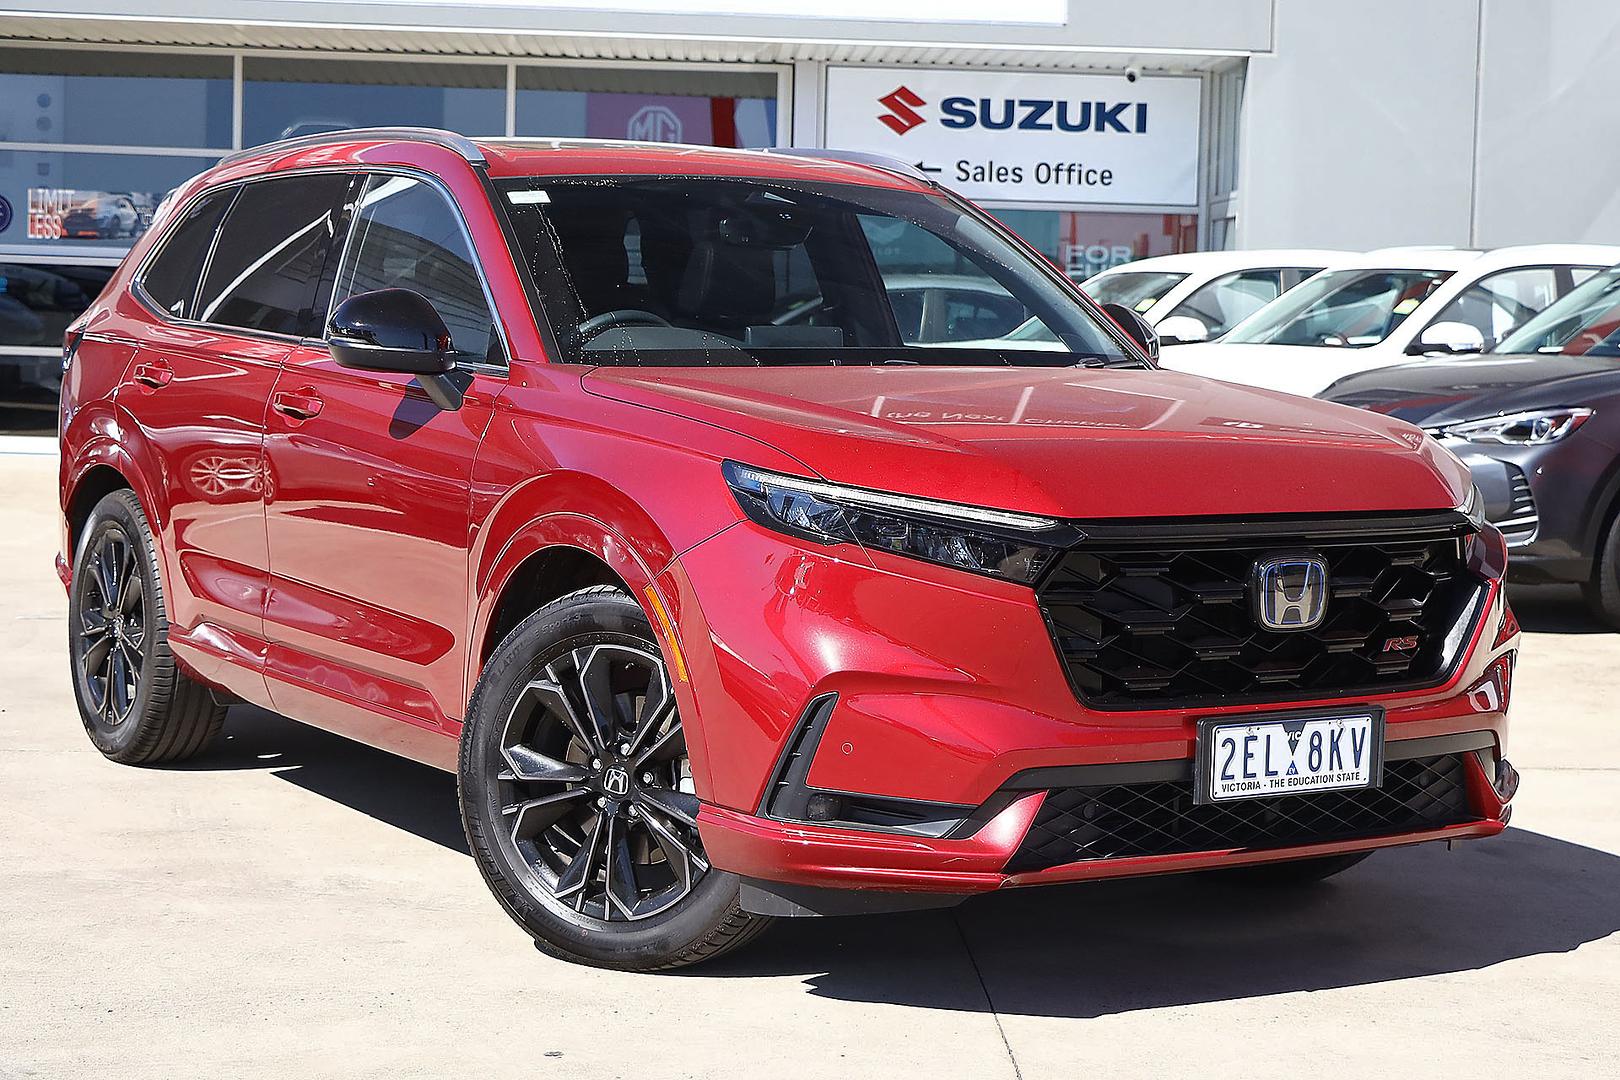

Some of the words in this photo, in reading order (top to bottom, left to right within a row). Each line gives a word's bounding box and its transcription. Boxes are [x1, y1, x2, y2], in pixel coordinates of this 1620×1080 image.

[632, 109, 679, 141] MG
[939, 96, 1148, 133] SUZUKI
[956, 160, 1023, 183] Sales
[1035, 162, 1113, 185] Office
[27, 188, 75, 213] LIMIT
[27, 214, 62, 239] LESS
[1065, 245, 1131, 263] FOR
[1382, 635, 1418, 652] RS
[1285, 730, 1302, 741] VIC
[1220, 734, 1278, 781] 2EL
[1308, 726, 1366, 772] 8KV
[1221, 781, 1261, 793] VICTORIA
[1270, 778, 1285, 788] THE
[1287, 774, 1334, 787] EDUCATION
[1336, 772, 1360, 782] STATE
